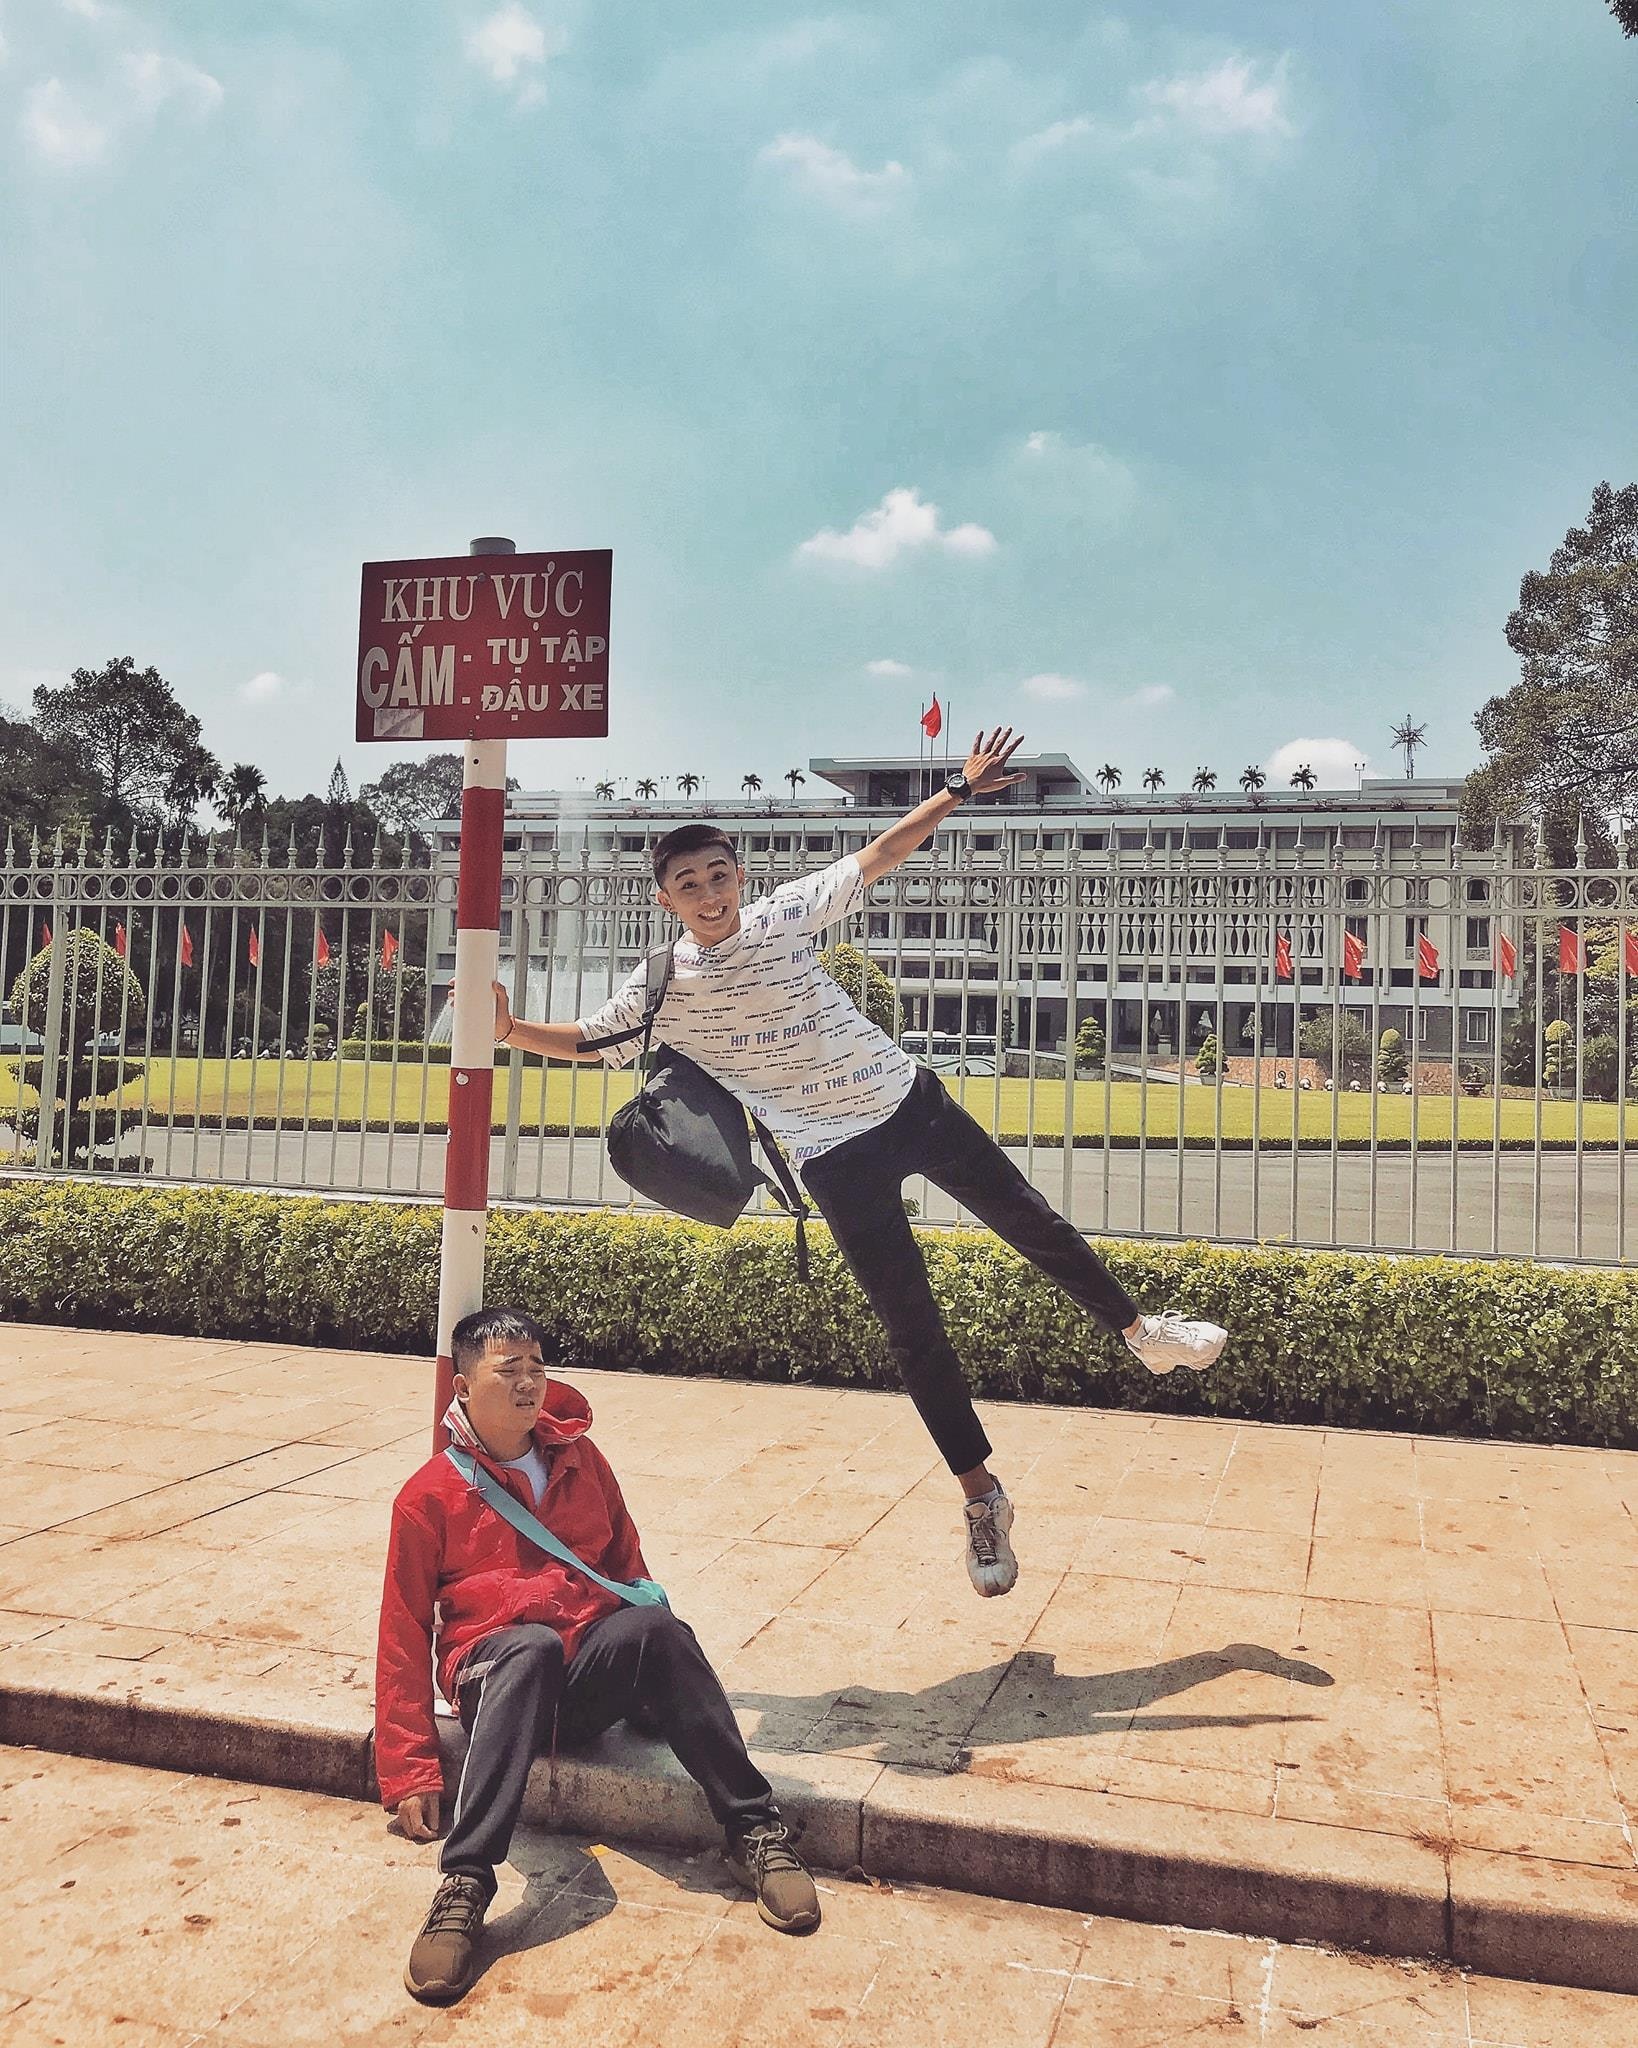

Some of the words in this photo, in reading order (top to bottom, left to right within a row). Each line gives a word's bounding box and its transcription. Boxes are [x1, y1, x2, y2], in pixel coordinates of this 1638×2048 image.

[381, 575, 478, 623] KHU
[490, 560, 584, 632] VỰC
[487, 637, 529, 673] TỤ
[540, 629, 606, 673] TẬP
[481, 678, 549, 721] ĐẬU
[559, 684, 604, 711] XE
[782, 905, 802, 921] THE
[731, 1034, 750, 1047] HIT
[755, 1030, 778, 1044] THE
[783, 1019, 817, 1040] ROAD
[801, 1082, 820, 1095] HIT
[824, 1075, 848, 1090] THE
[852, 1062, 883, 1084] ROAD
